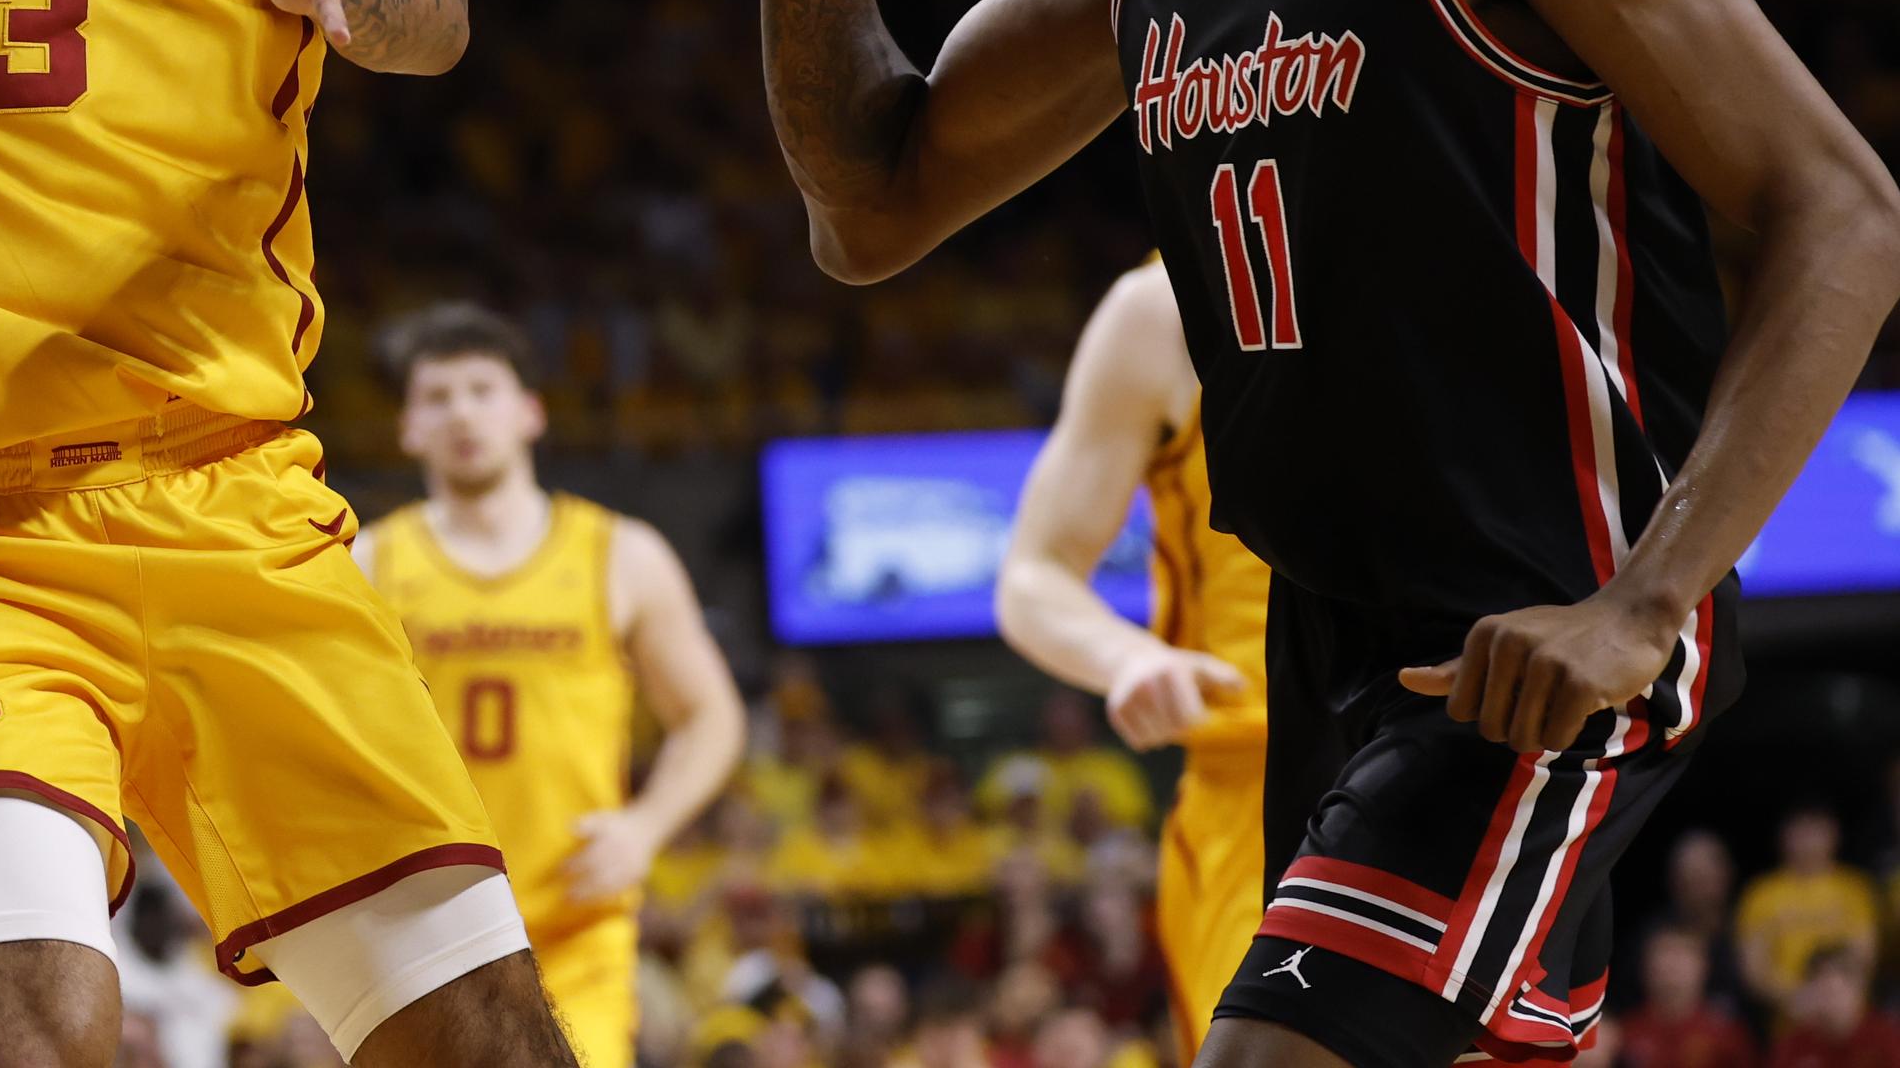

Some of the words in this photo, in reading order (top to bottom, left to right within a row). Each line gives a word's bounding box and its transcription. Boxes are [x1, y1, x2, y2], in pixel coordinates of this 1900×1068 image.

[1134, 11, 1366, 154] Houston
[1210, 159, 1302, 351] 11
[50, 454, 87, 468] HILTON
[462, 677, 517, 763] 0
